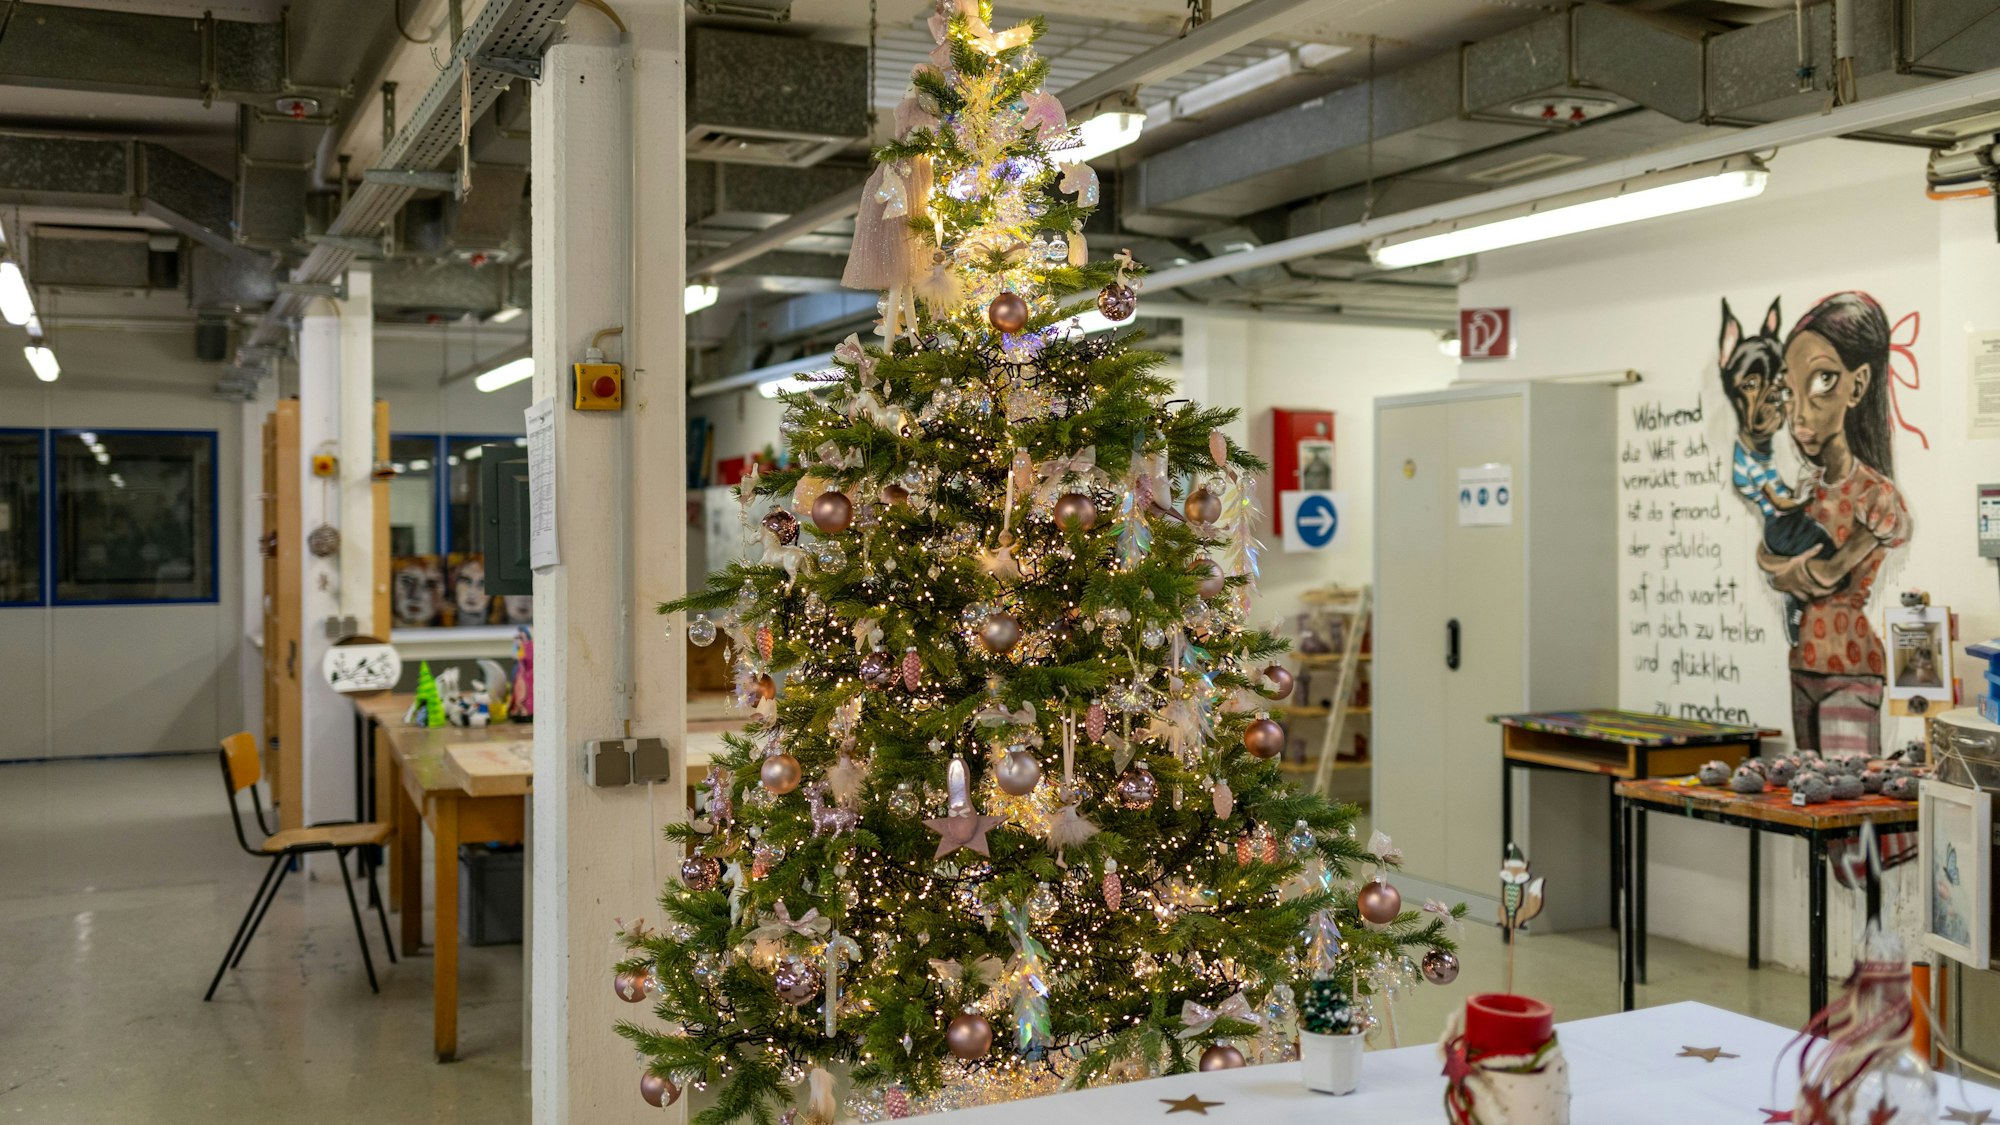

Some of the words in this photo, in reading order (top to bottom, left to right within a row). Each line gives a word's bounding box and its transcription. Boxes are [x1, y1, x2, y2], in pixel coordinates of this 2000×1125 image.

[1633, 391, 1703, 432] Während
[1648, 438, 1677, 462] Welt
[1684, 434, 1710, 458] dich
[1656, 576, 1684, 605] dich
[1631, 620, 1650, 636] um
[1659, 610, 1688, 639] dich
[1695, 622, 1714, 640] zu
[1721, 611, 1766, 645] heilen
[1635, 641, 1660, 672] und
[1671, 648, 1740, 686] glücklich
[1655, 700, 1672, 717] zu
